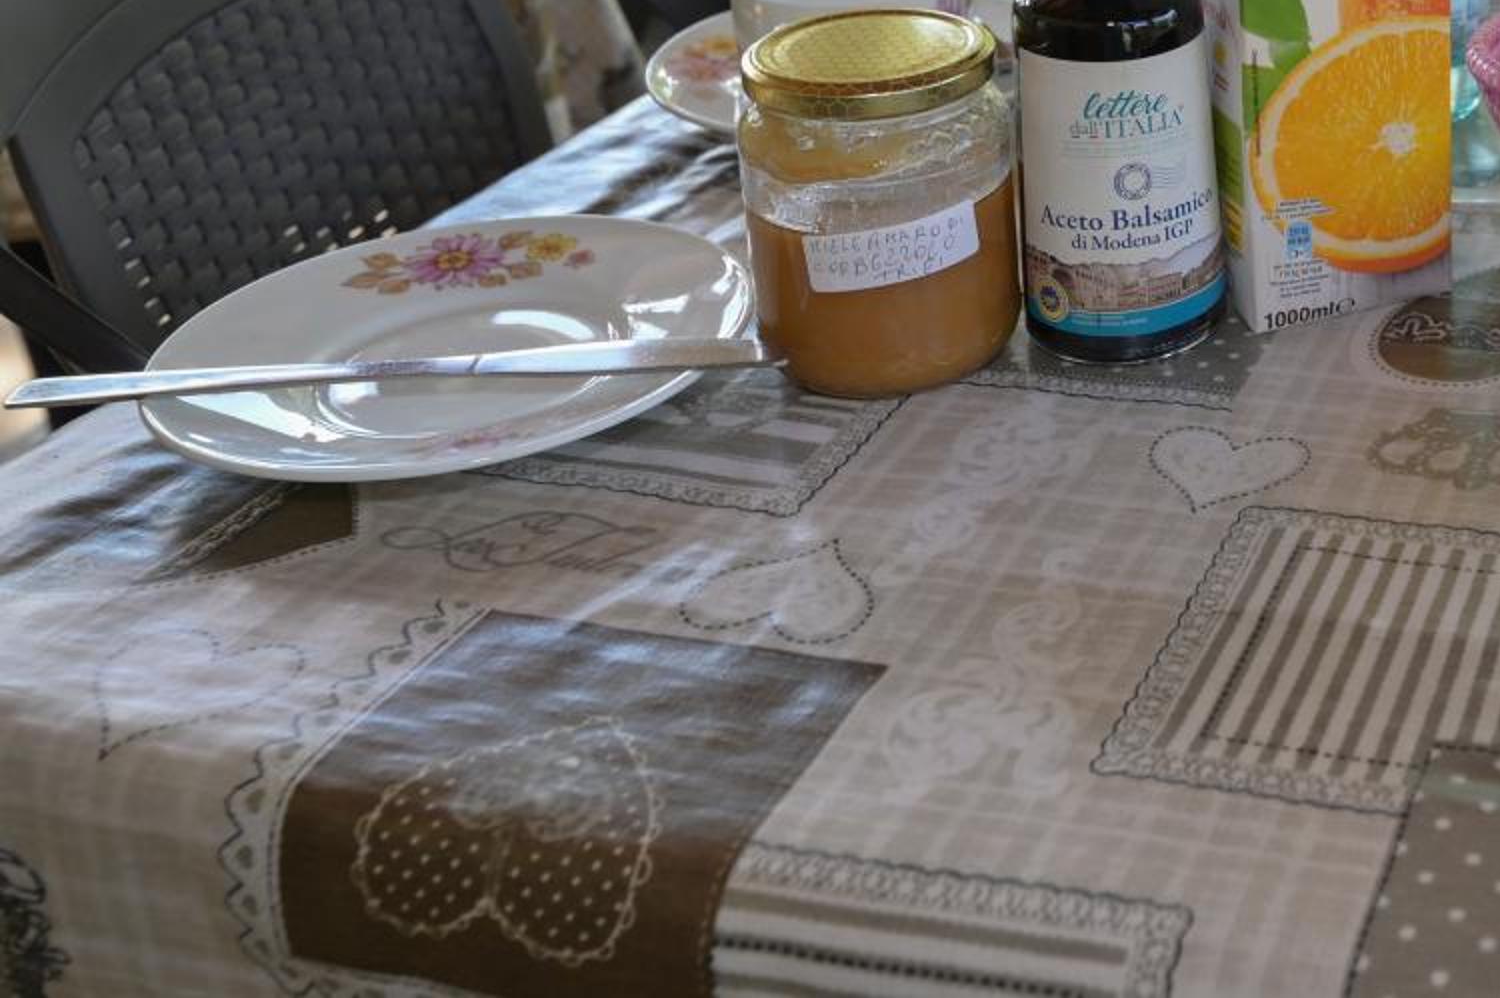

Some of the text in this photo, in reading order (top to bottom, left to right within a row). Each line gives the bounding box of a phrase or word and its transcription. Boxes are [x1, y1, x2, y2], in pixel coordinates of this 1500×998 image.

[1041, 189, 1213, 230] Aceto Balsamico
[1071, 219, 1193, 250] di Modena IGP
[1264, 301, 1333, 329] 1000ml
